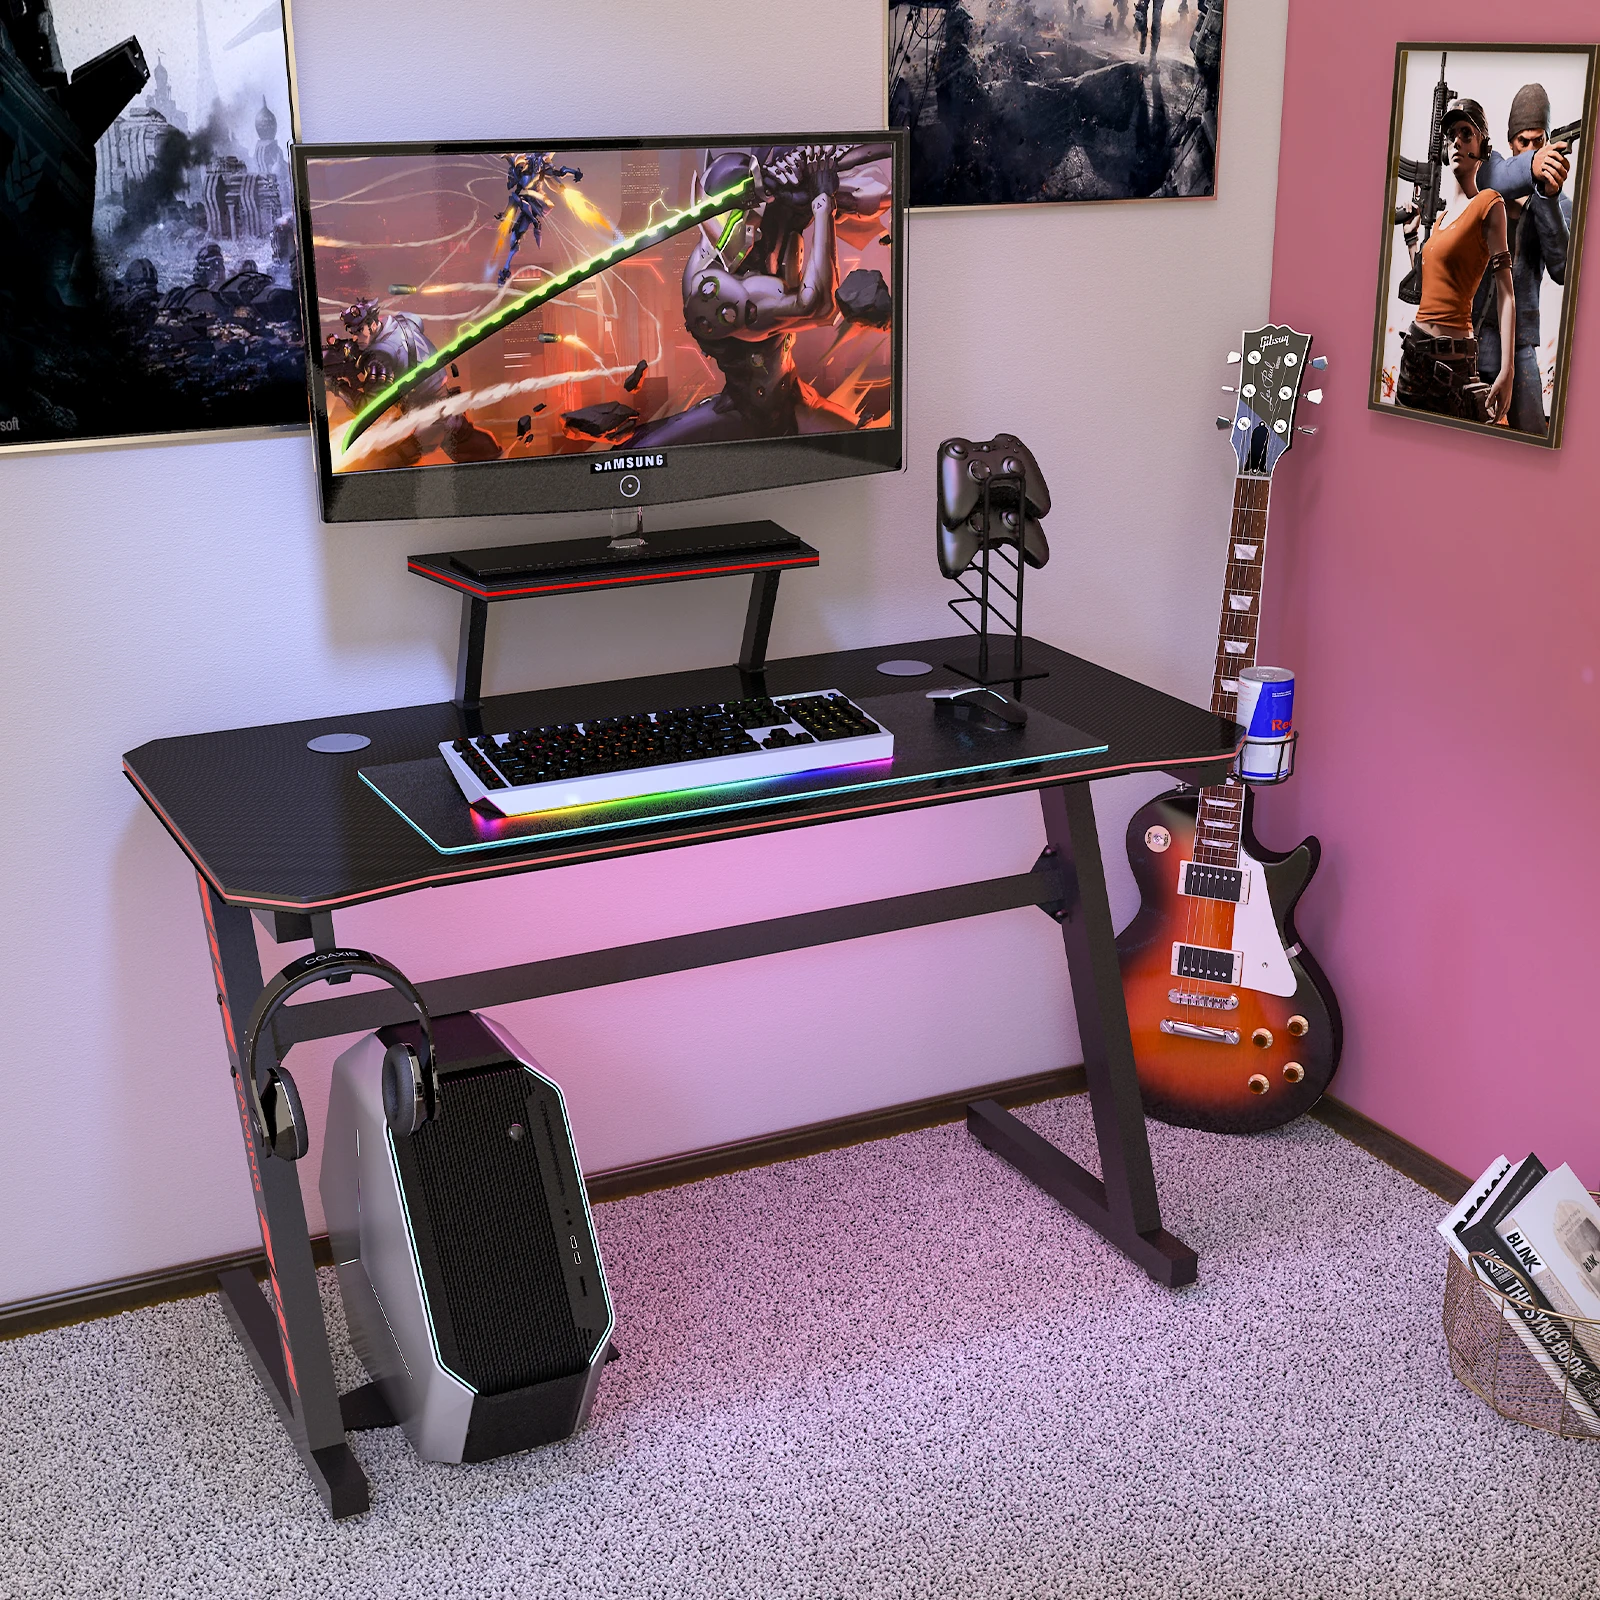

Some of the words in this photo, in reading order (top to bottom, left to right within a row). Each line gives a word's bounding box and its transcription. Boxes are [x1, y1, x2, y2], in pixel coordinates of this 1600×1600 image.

[1260, 334, 1289, 352] Gibson
[594, 454, 664, 472] SAMSUNG
[305, 951, 359, 965] COAXIS
[236, 1072, 261, 1192] GAMING
[1506, 1232, 1541, 1273] BLINK
